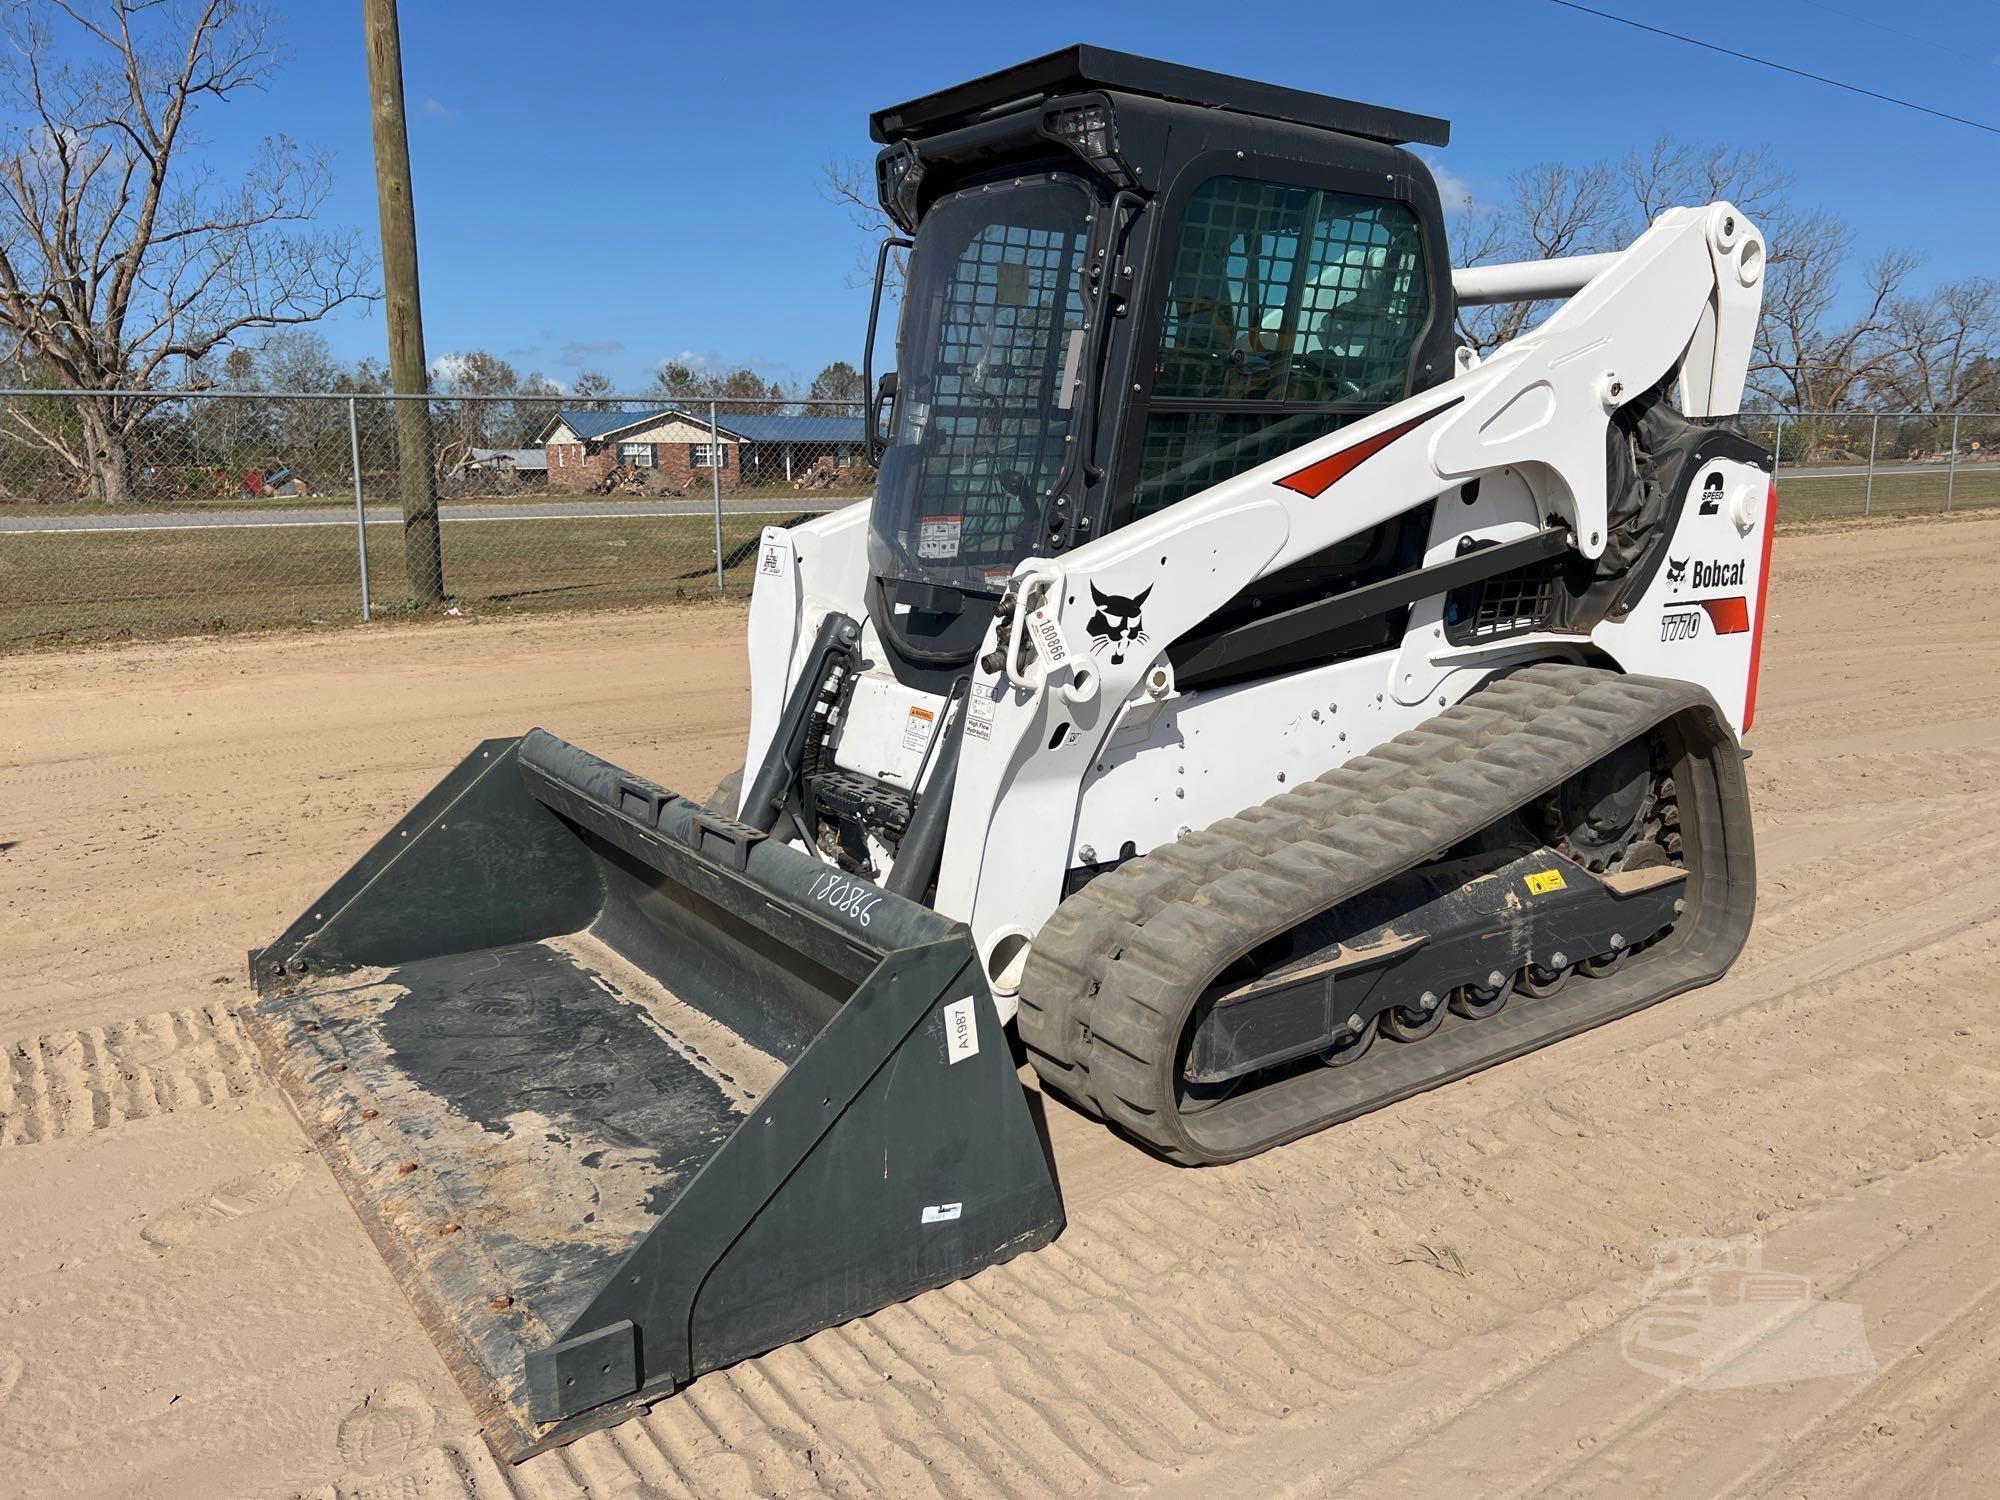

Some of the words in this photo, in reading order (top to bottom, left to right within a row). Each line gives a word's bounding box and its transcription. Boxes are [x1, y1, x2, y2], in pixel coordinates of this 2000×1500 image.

[1701, 491, 1725, 501] SPEED
[1692, 558, 1745, 588] Bobcat
[1039, 618, 1066, 661] 180866
[1661, 612, 1700, 642] T770
[808, 873, 882, 926] 180866
[955, 1011, 969, 1049] A1987
